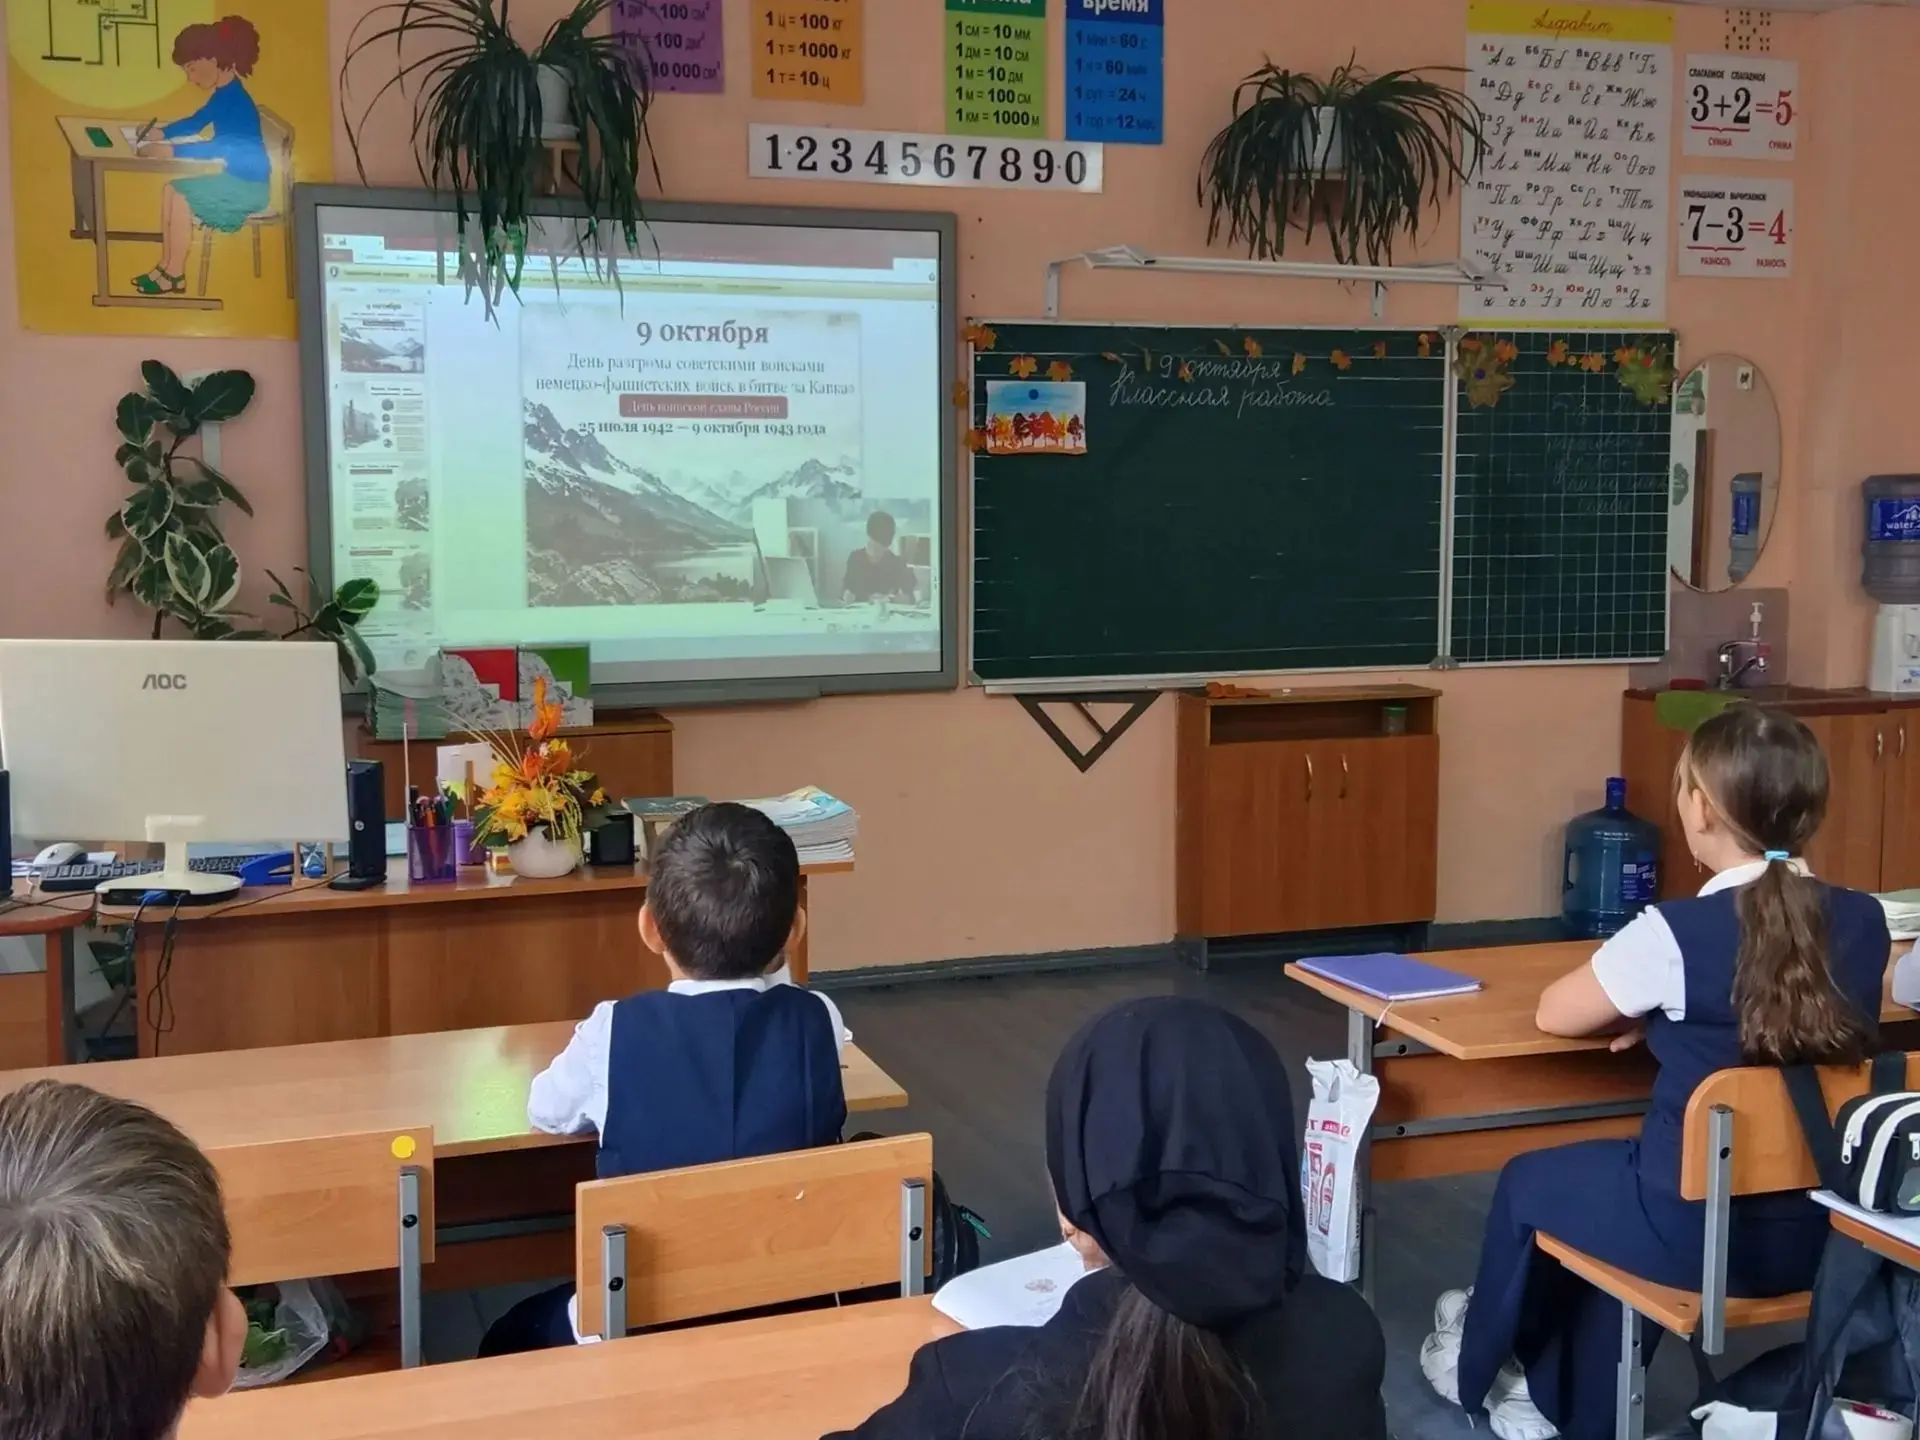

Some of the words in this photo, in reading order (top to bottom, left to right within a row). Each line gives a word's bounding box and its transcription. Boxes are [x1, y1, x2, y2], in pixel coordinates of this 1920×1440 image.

[660, 3, 688, 20] 100
[766, 11, 773, 26] 1
[800, 13, 829, 30] 100
[956, 21, 963, 35] 1
[965, 25, 979, 37] см
[993, 24, 1012, 39] 10
[1014, 29, 1031, 40] мм
[655, 32, 682, 48] 100
[766, 40, 774, 55] 1
[799, 42, 838, 58] 1000
[1120, 33, 1138, 48] 60
[956, 42, 963, 57] 1
[965, 47, 980, 60] дм
[995, 46, 1013, 60] 10
[1015, 51, 1029, 61] см
[956, 64, 963, 79] 1
[988, 66, 1006, 81] 10
[1008, 71, 1023, 83] дм
[1105, 60, 1123, 75] 60
[767, 68, 774, 83] 1
[800, 71, 818, 86] 10
[956, 86, 963, 100] 1
[988, 88, 1015, 103] 100
[1017, 93, 1031, 104] см
[1118, 88, 1136, 102] 24
[956, 108, 963, 122] 1
[966, 112, 979, 122] км
[993, 110, 1030, 126] 1000
[1116, 114, 1134, 129] 12
[636, 322, 652, 346] 9
[660, 320, 769, 350] октября
[567, 353, 604, 371] День
[608, 356, 672, 373] разгрома
[676, 357, 755, 372] советскими
[761, 357, 825, 373] войсками
[1160, 354, 1173, 378] 9
[1187, 355, 1281, 388] октября
[536, 376, 690, 394] немецко-фашистских
[739, 382, 746, 393] в
[749, 379, 788, 393] битве
[1109, 361, 1230, 408] Классная
[1236, 379, 1336, 420] работа
[628, 400, 655, 414] День
[579, 422, 596, 436] 25
[598, 422, 639, 434] июля
[642, 422, 673, 436] 1942
[692, 423, 701, 436] 9
[704, 421, 760, 438] октября
[764, 423, 794, 437] 1943
[795, 423, 827, 437] года
[142, 673, 188, 690] AOC
